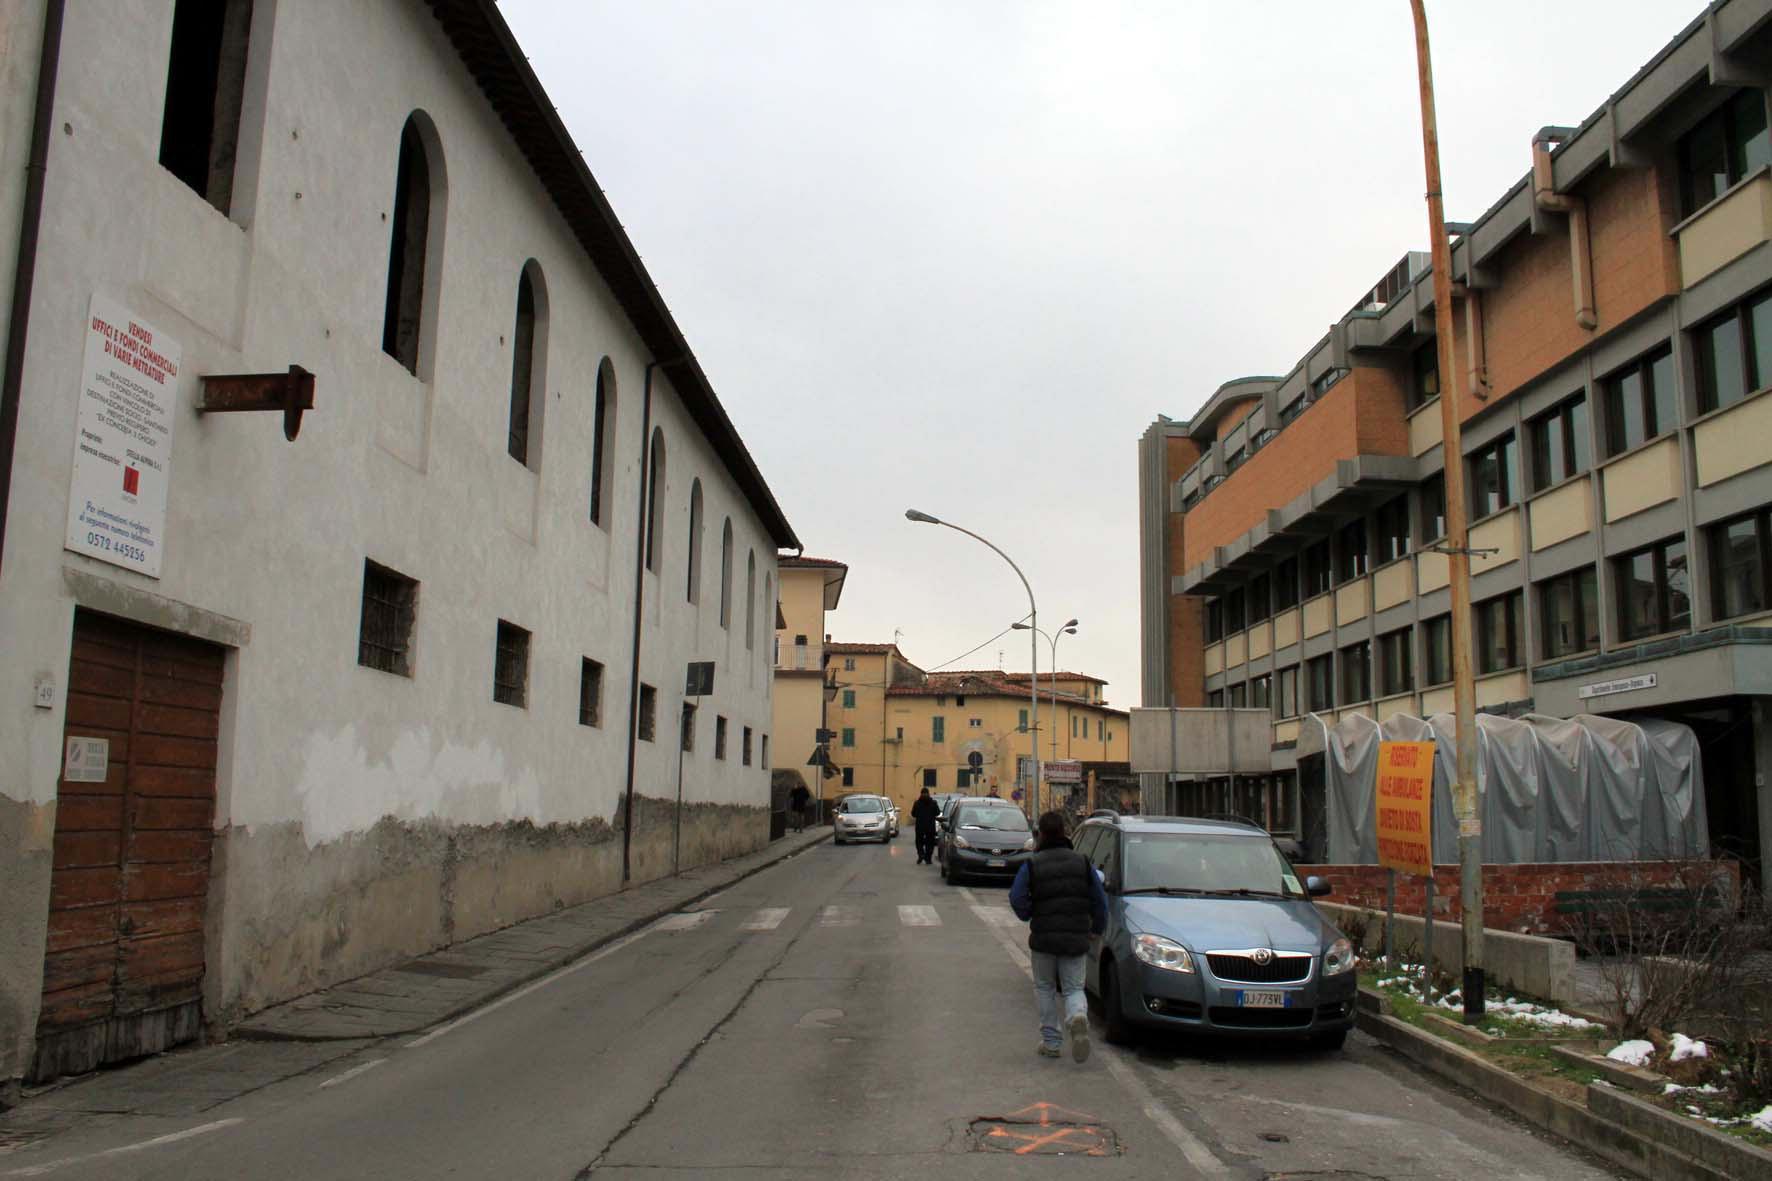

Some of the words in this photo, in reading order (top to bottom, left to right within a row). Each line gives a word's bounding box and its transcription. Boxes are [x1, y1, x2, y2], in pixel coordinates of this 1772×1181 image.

[92, 317, 113, 338] UFFICI
[114, 328, 119, 342] E
[119, 331, 139, 354] FONDI
[139, 344, 177, 378] COMMERCIALI
[128, 320, 153, 346] VENDESI
[104, 340, 113, 355] DI
[113, 344, 132, 366] VARIE
[132, 356, 165, 385] METRATURE
[87, 531, 112, 550] 0572
[113, 541, 145, 563] 445256
[40, 687, 53, 701] 49
